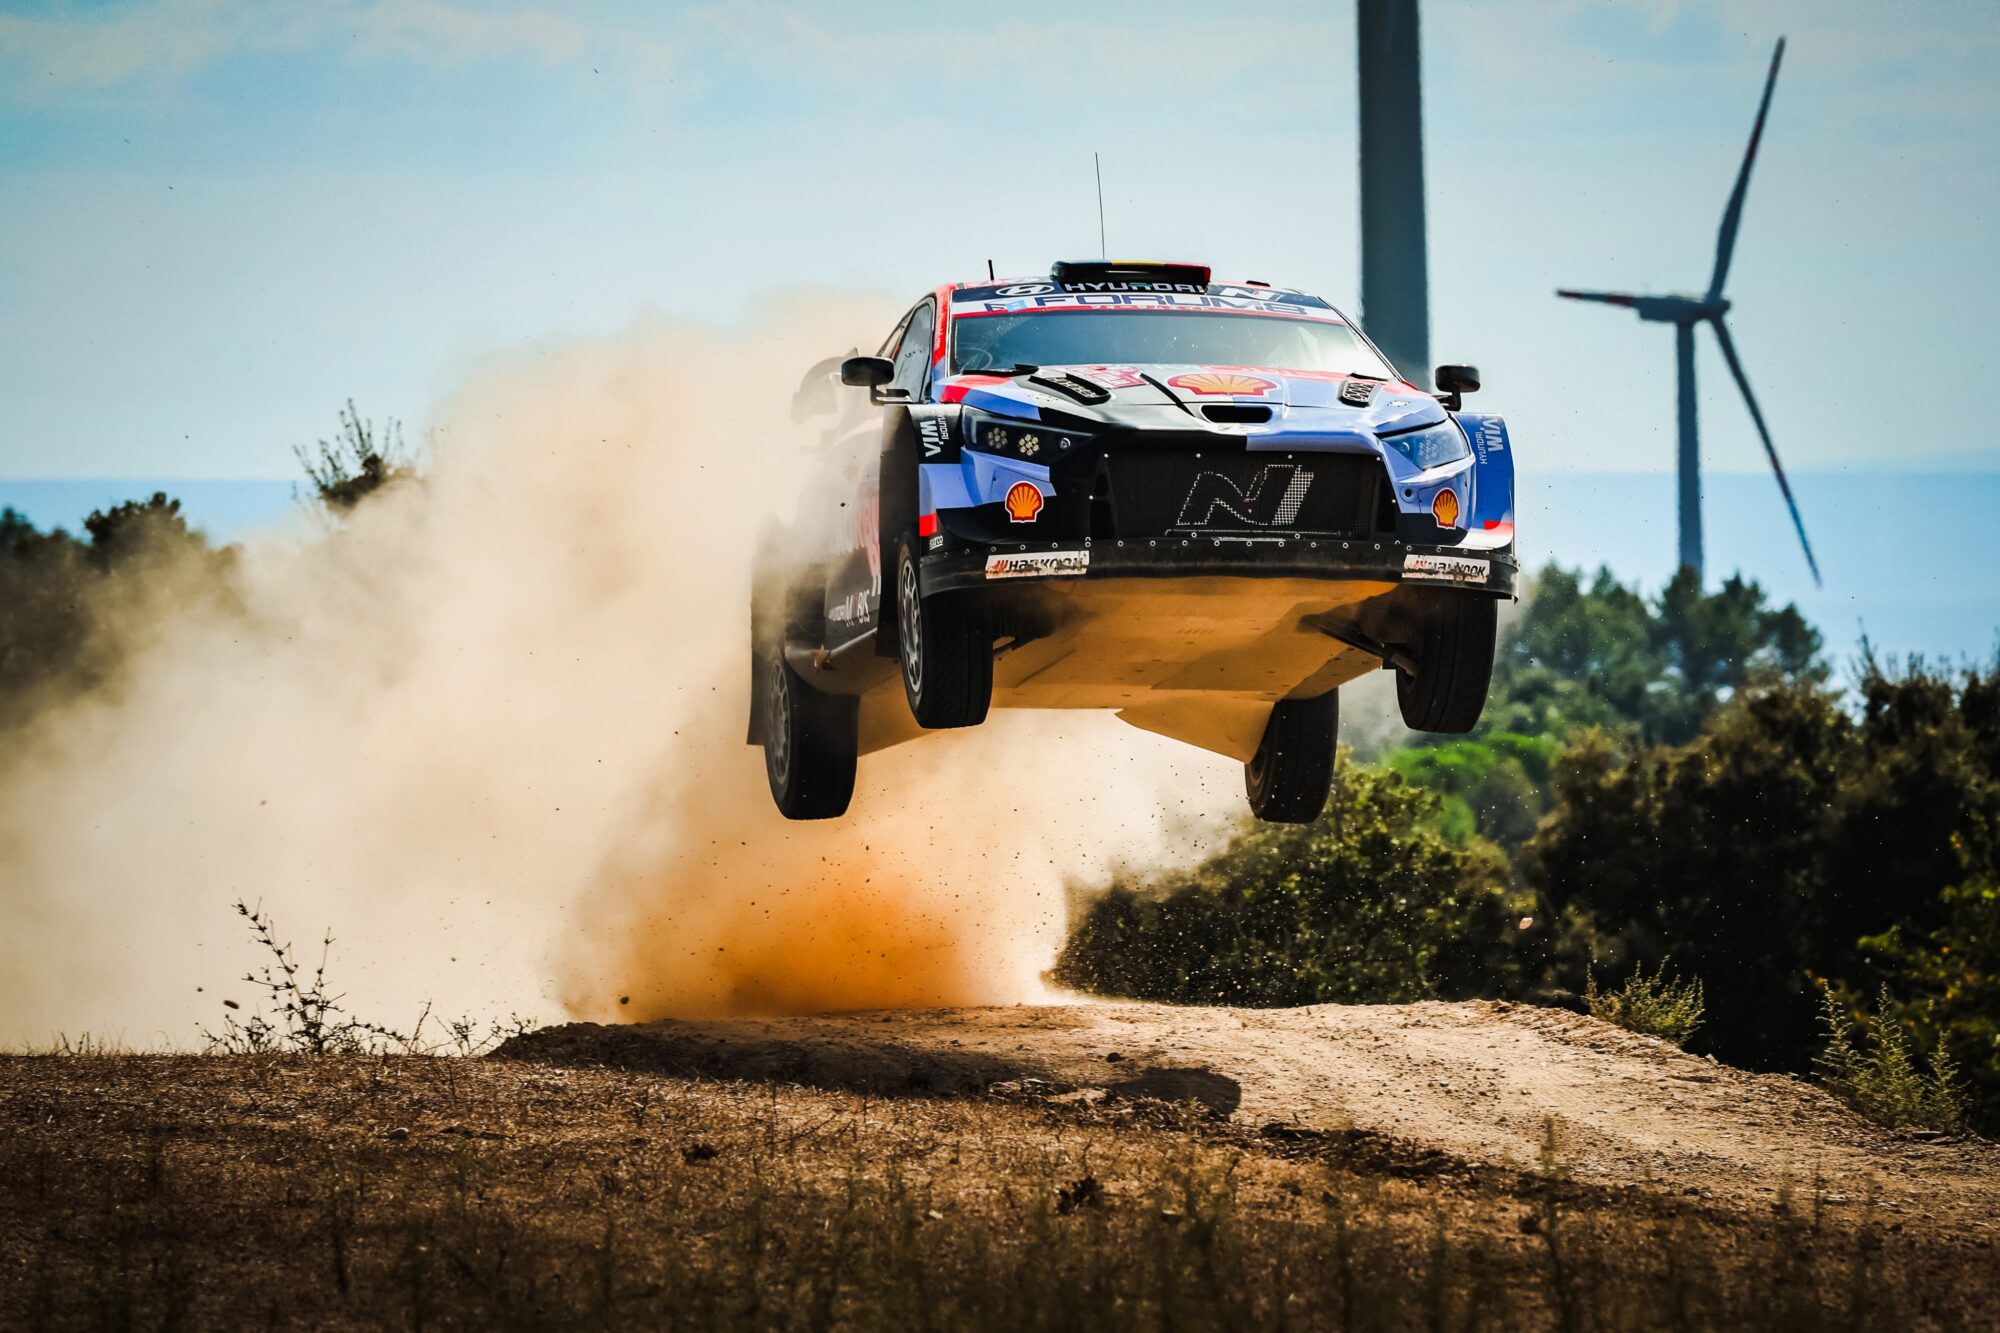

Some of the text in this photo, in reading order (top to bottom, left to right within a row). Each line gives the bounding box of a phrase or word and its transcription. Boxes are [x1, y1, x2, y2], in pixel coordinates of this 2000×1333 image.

[1064, 282, 1204, 293] HYUNDAI
[1034, 295, 1308, 316] FORUM8
[920, 420, 943, 457] WIA
[1475, 431, 1488, 465] HYUNDAI
[1481, 418, 1504, 452] WIA
